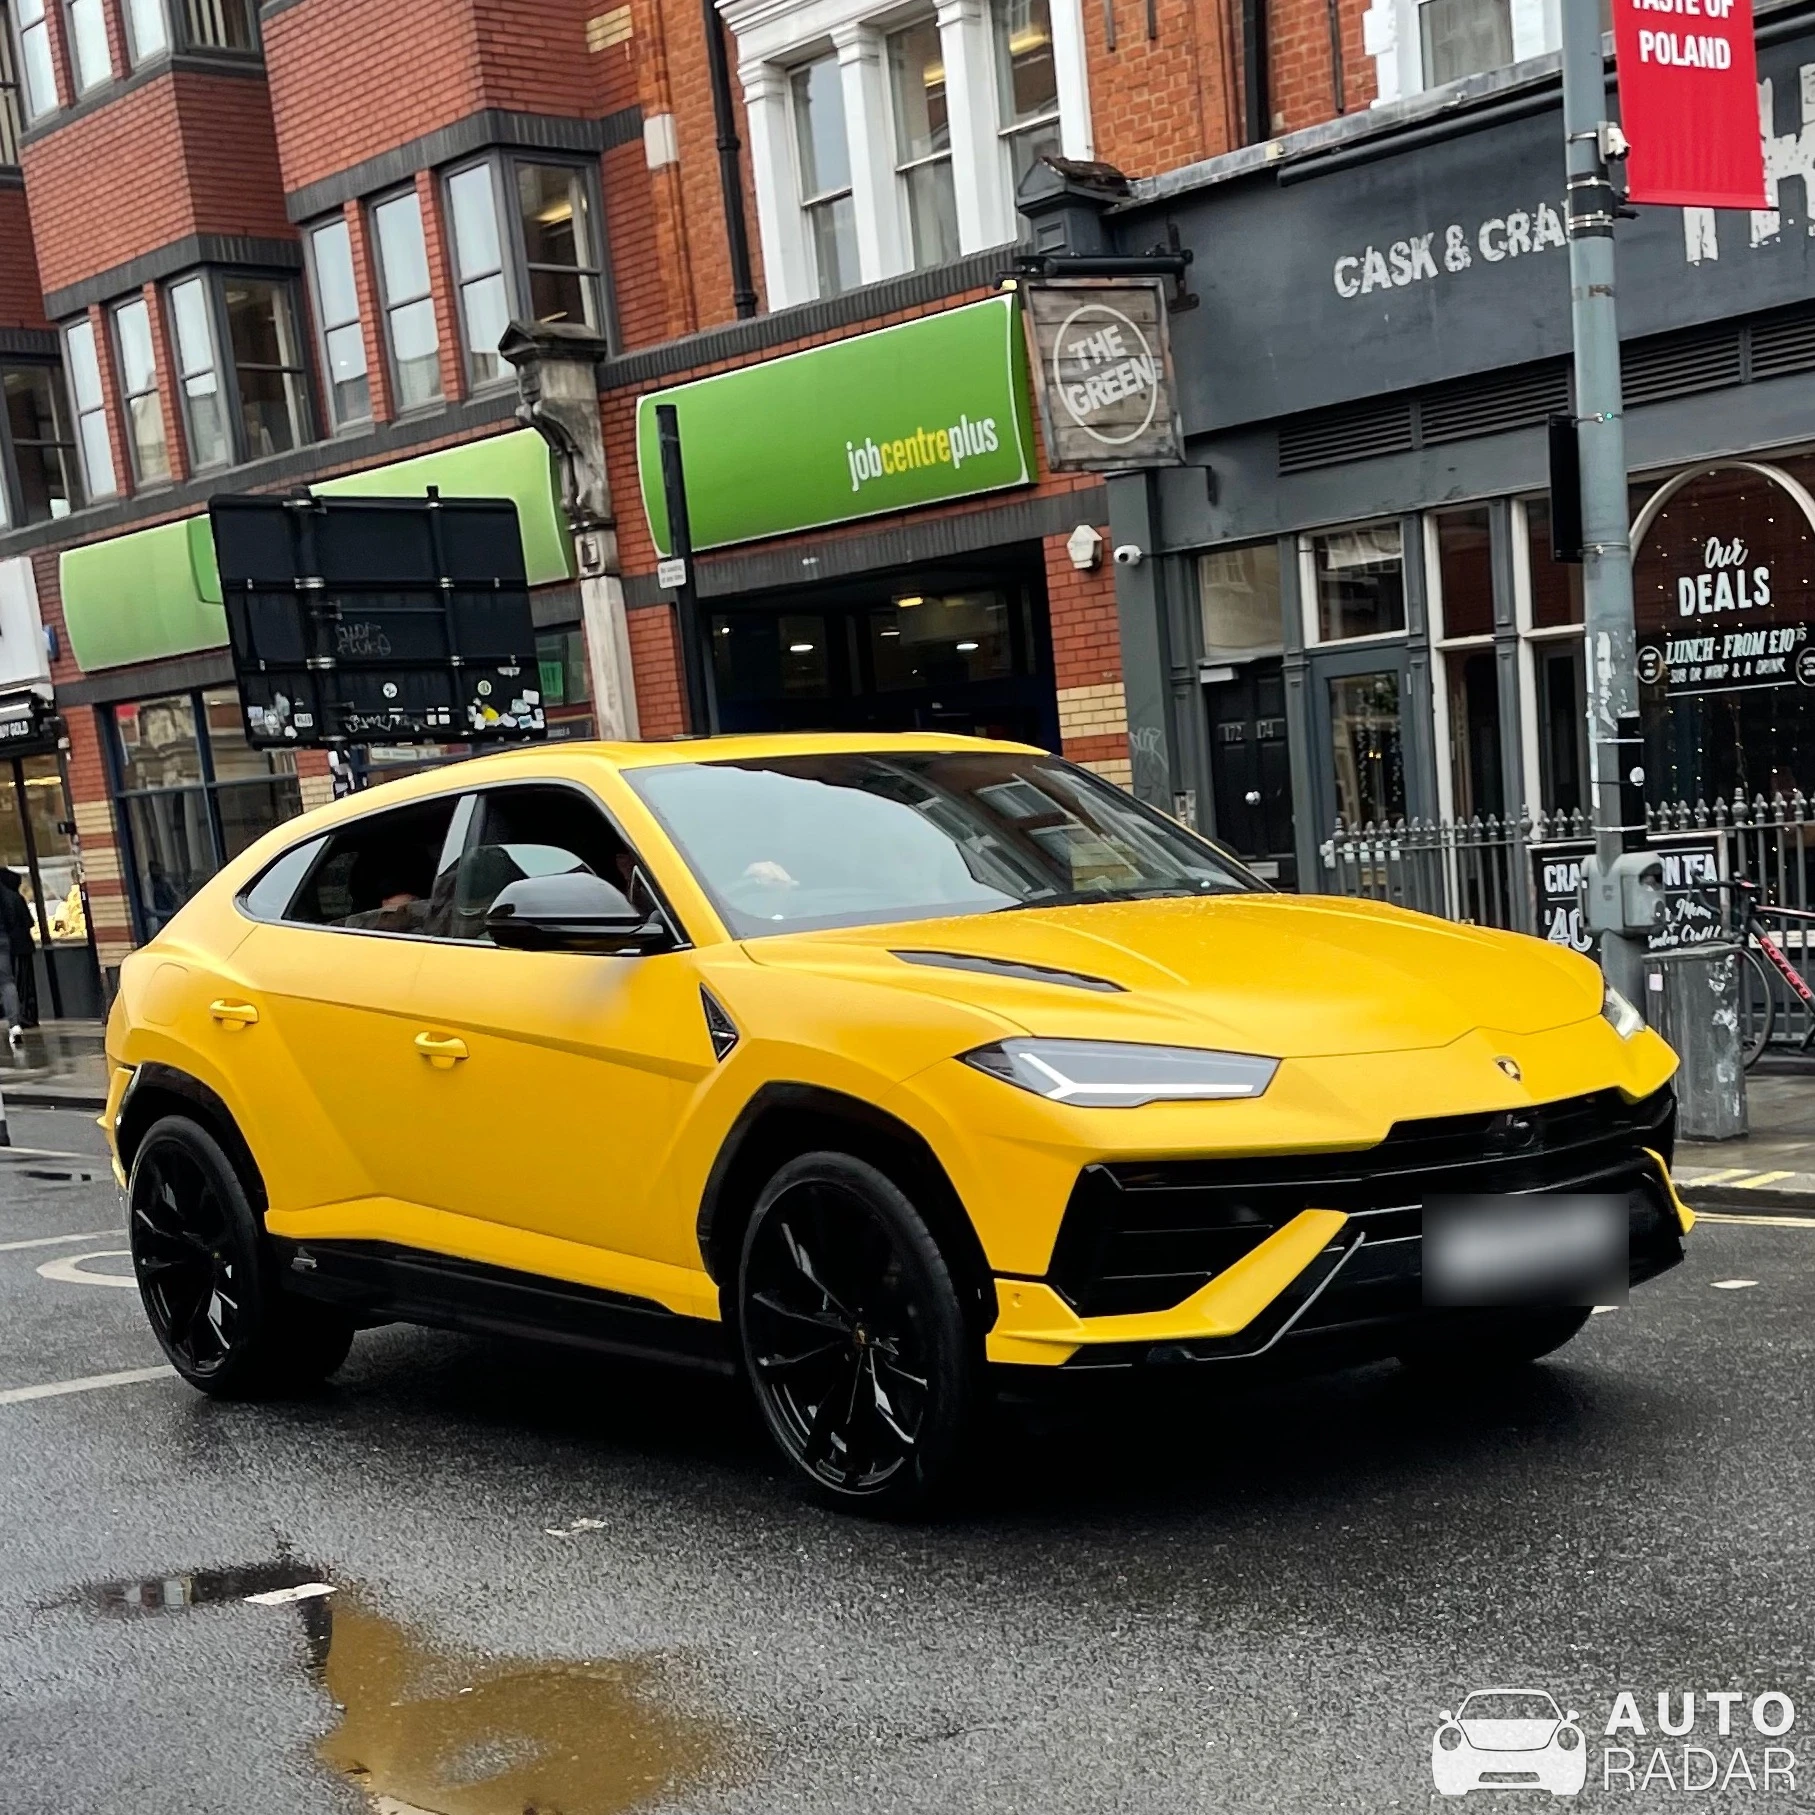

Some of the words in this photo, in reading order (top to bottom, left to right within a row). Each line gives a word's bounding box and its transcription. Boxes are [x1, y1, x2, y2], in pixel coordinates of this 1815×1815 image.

[1632, 0, 1701, 16] STE
[1638, 29, 1732, 70] POLAND
[1333, 232, 1439, 298] CASK
[1444, 224, 1473, 273] &
[1478, 199, 1570, 262] CRA
[1067, 324, 1128, 371] THE
[1066, 353, 1155, 416] GREEN
[846, 413, 999, 492] jobcentreplus
[1705, 536, 1749, 569] Our
[1678, 566, 1770, 617] DEALS
[1664, 637, 1716, 665] LUNCH
[1721, 630, 1768, 659] FROM
[1543, 863, 1588, 893] CRA
